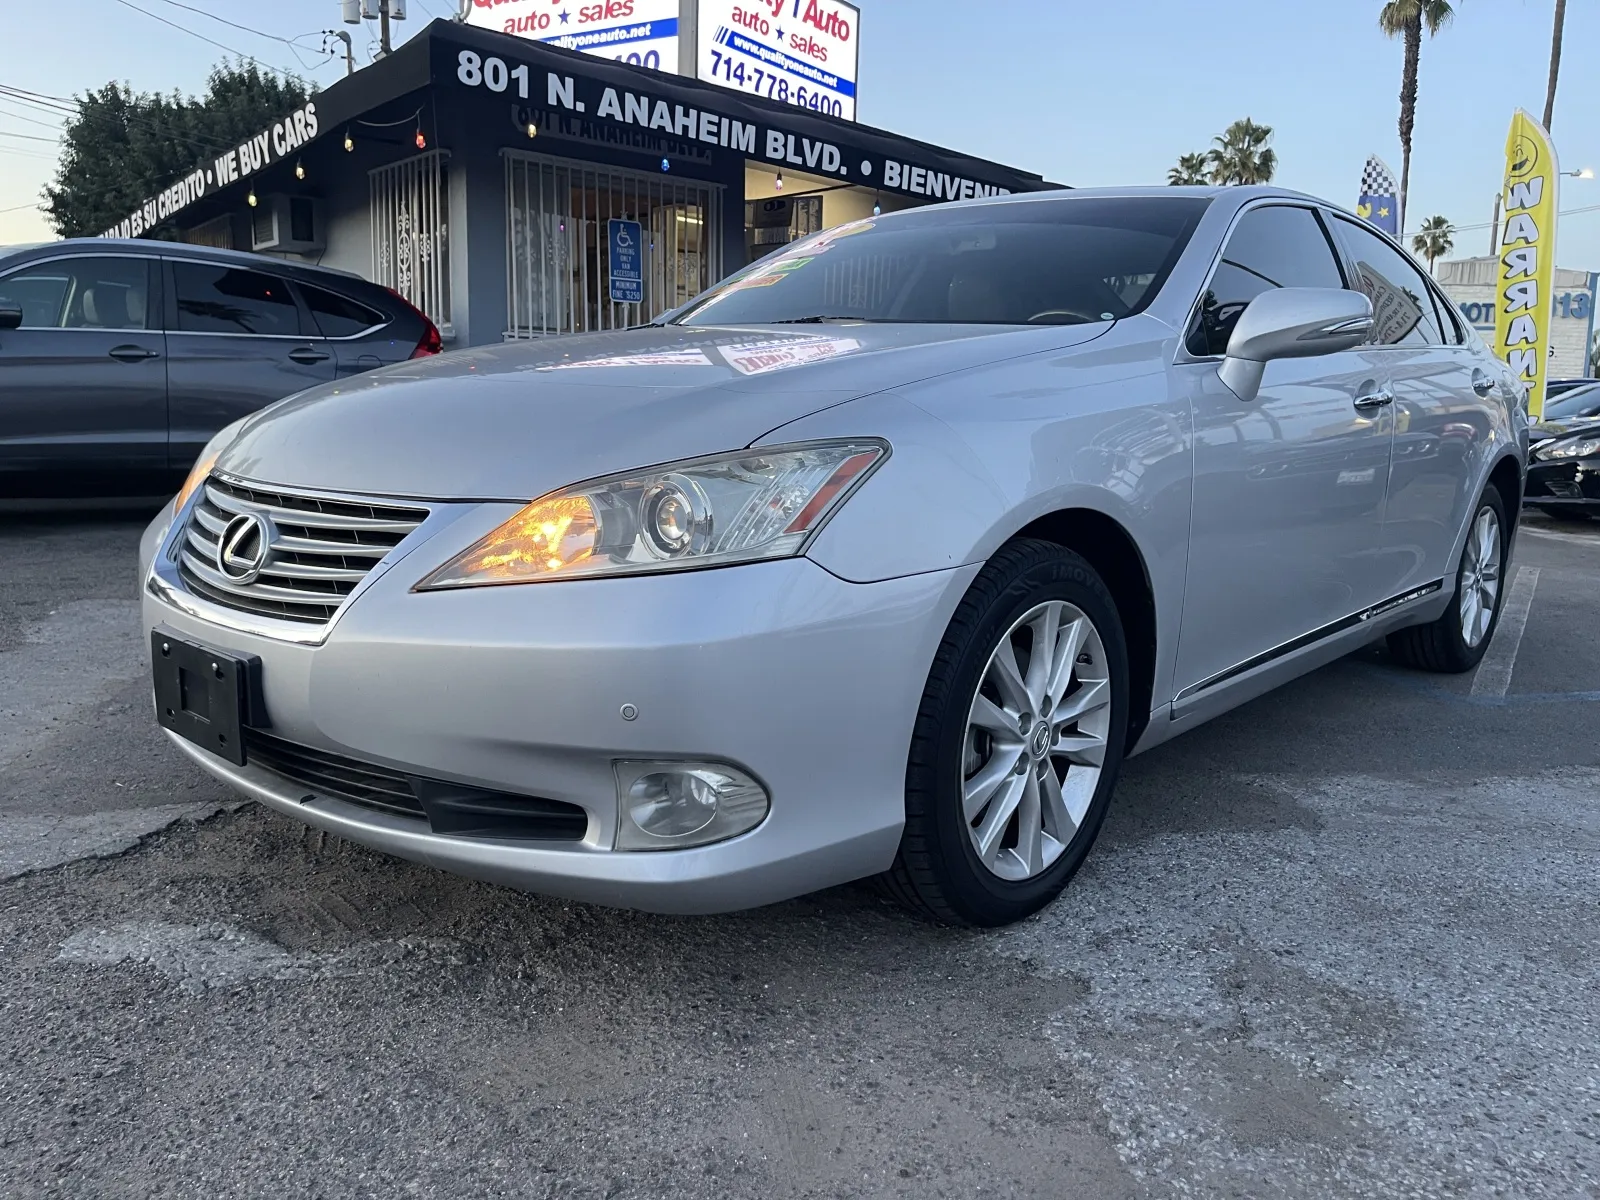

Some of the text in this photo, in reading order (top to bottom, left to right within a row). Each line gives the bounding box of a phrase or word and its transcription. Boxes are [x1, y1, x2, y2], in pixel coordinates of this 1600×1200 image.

[503, 0, 634, 34] auto sales
[731, 6, 828, 62] auto sales
[802, 0, 850, 42] Auto
[711, 49, 842, 117] 714-778-6400
[733, 35, 838, 88] www.qualityoneauto.net
[457, 50, 529, 98] 801
[547, 73, 585, 113] N.
[597, 88, 756, 154] ANAHEIM
[766, 129, 848, 175] BLVD.
[131, 209, 143, 238] ES
[143, 199, 157, 230] SU
[158, 168, 205, 220] CREDITO
[215, 150, 239, 187] WE
[239, 130, 270, 176] BUY
[272, 102, 318, 157] CARS
[612, 290, 623, 299] FINE
[615, 281, 637, 290] MINIMUM
